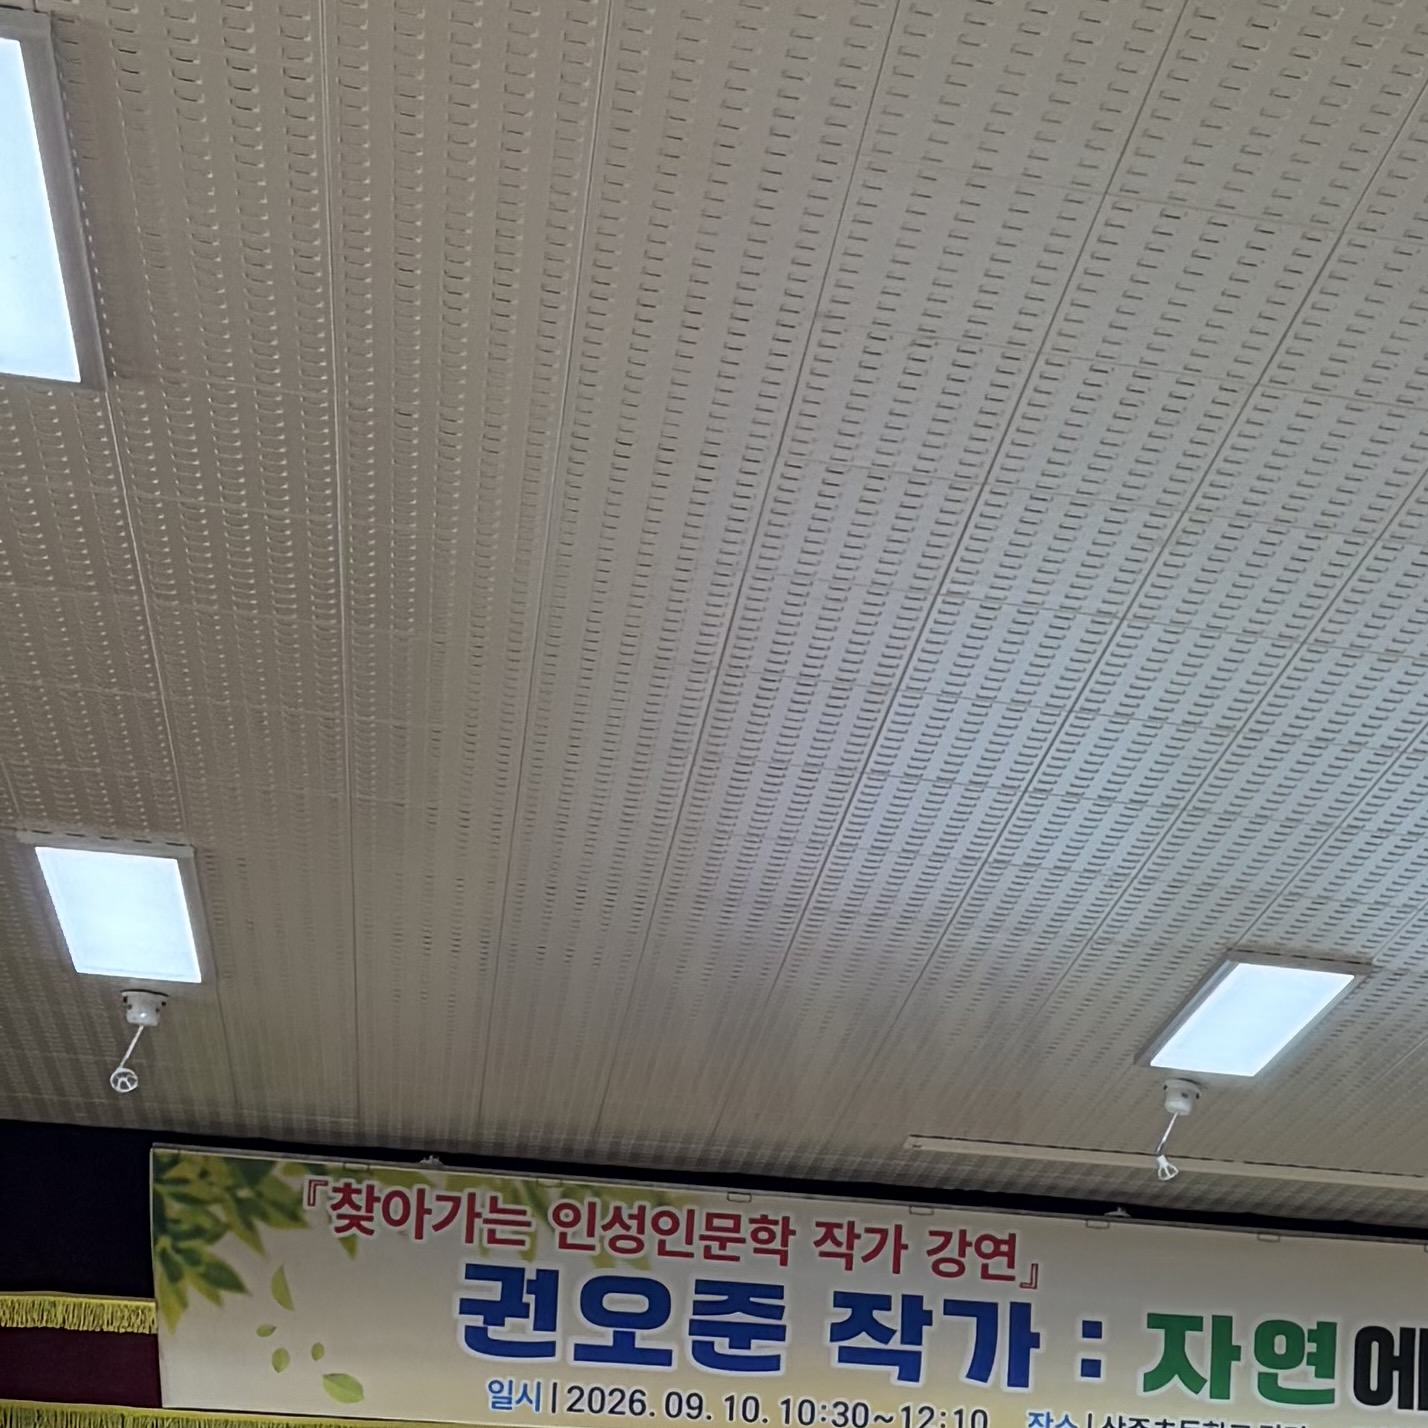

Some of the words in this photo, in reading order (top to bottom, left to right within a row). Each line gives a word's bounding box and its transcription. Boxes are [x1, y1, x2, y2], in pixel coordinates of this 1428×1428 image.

[553, 1199, 797, 1265] 인성인문학
[813, 1218, 908, 1276] 작가
[457, 1261, 788, 1374] 권오준
[828, 1290, 1042, 1390] 작가
[487, 1378, 543, 1414] 일시
